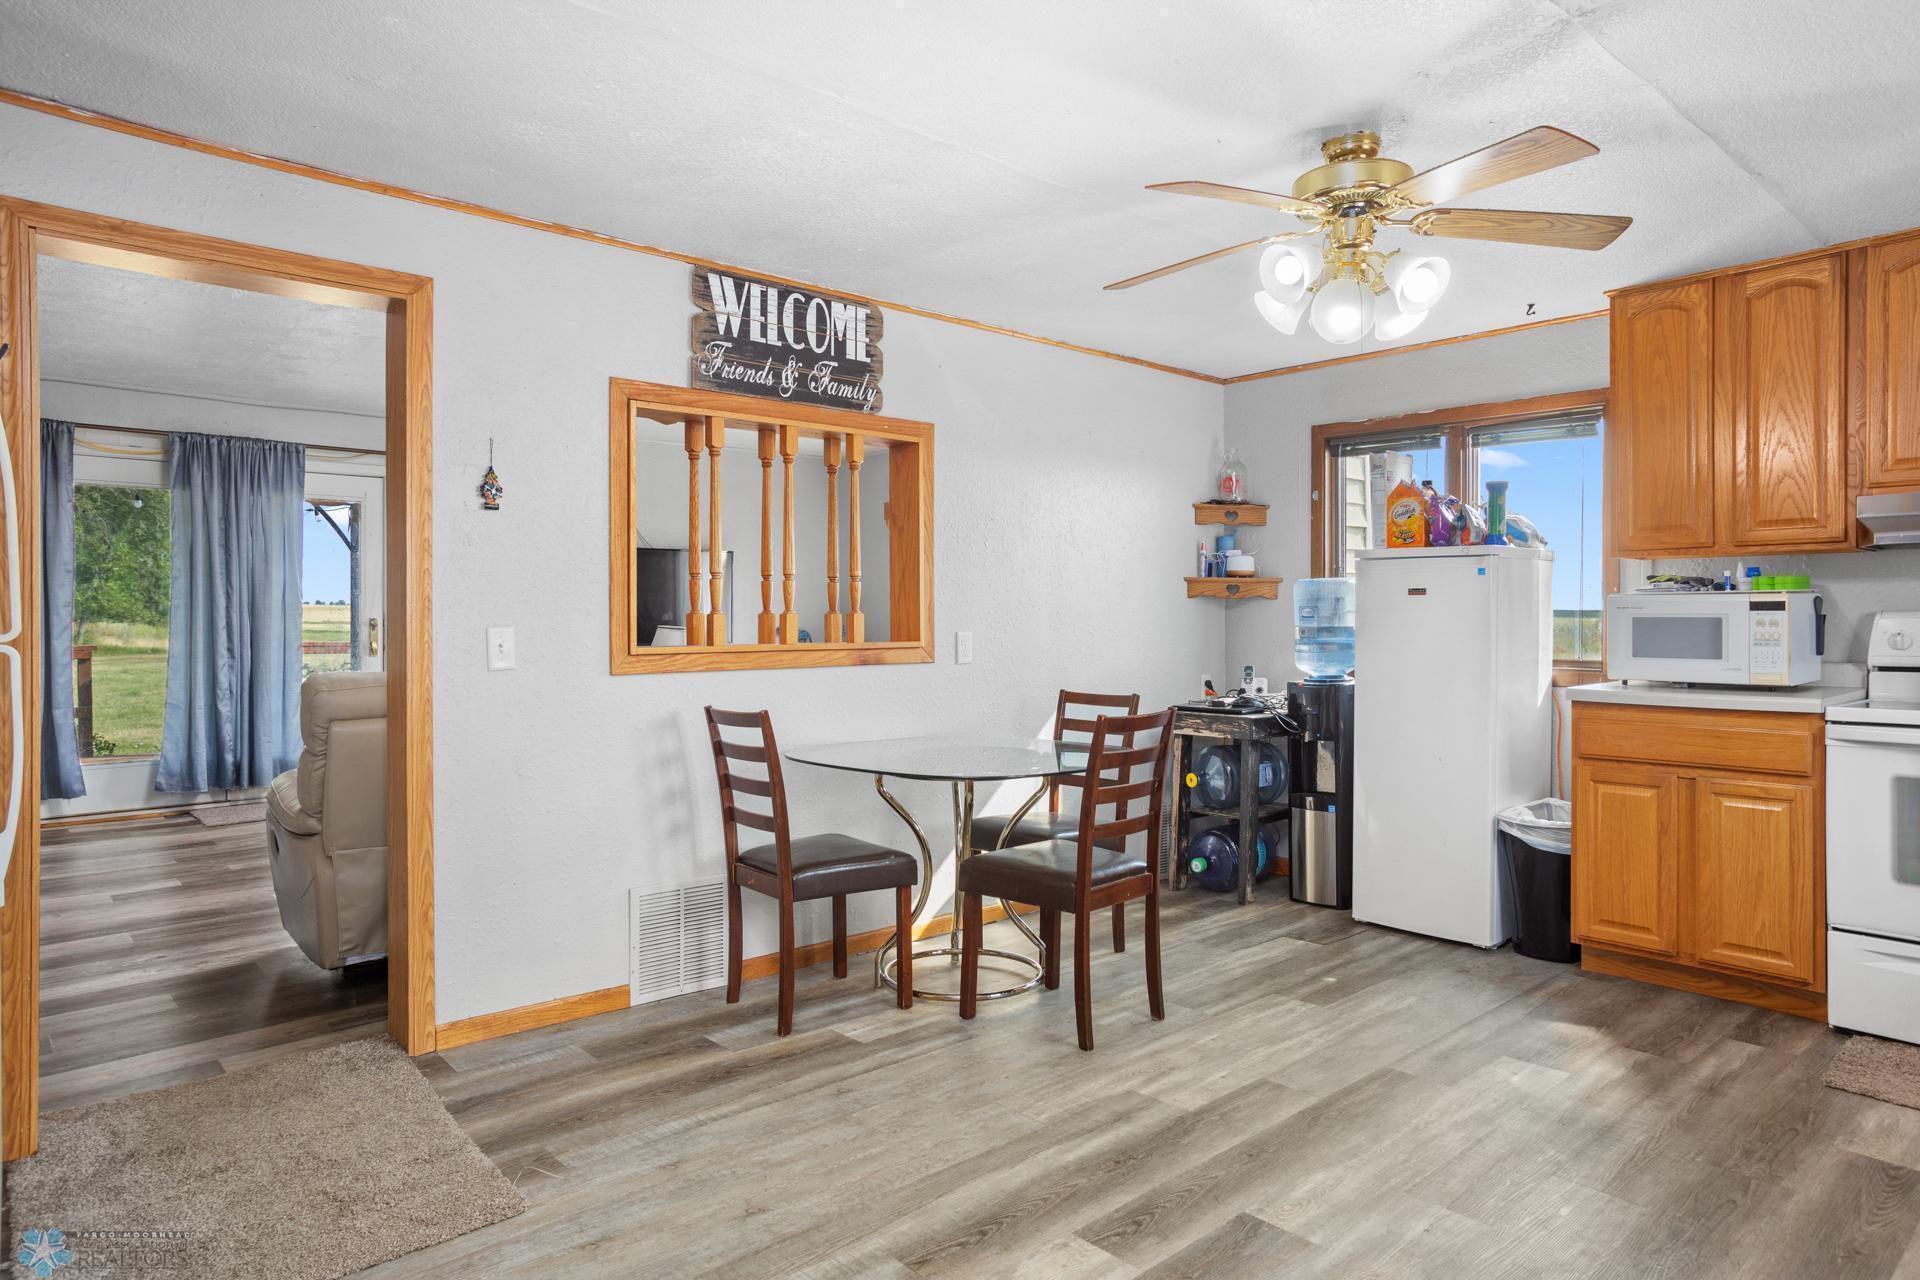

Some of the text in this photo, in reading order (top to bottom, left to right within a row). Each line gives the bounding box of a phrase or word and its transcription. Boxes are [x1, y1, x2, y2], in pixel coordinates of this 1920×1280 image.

[707, 272, 872, 363] WELCOME
[698, 340, 878, 413] Friends & Family
